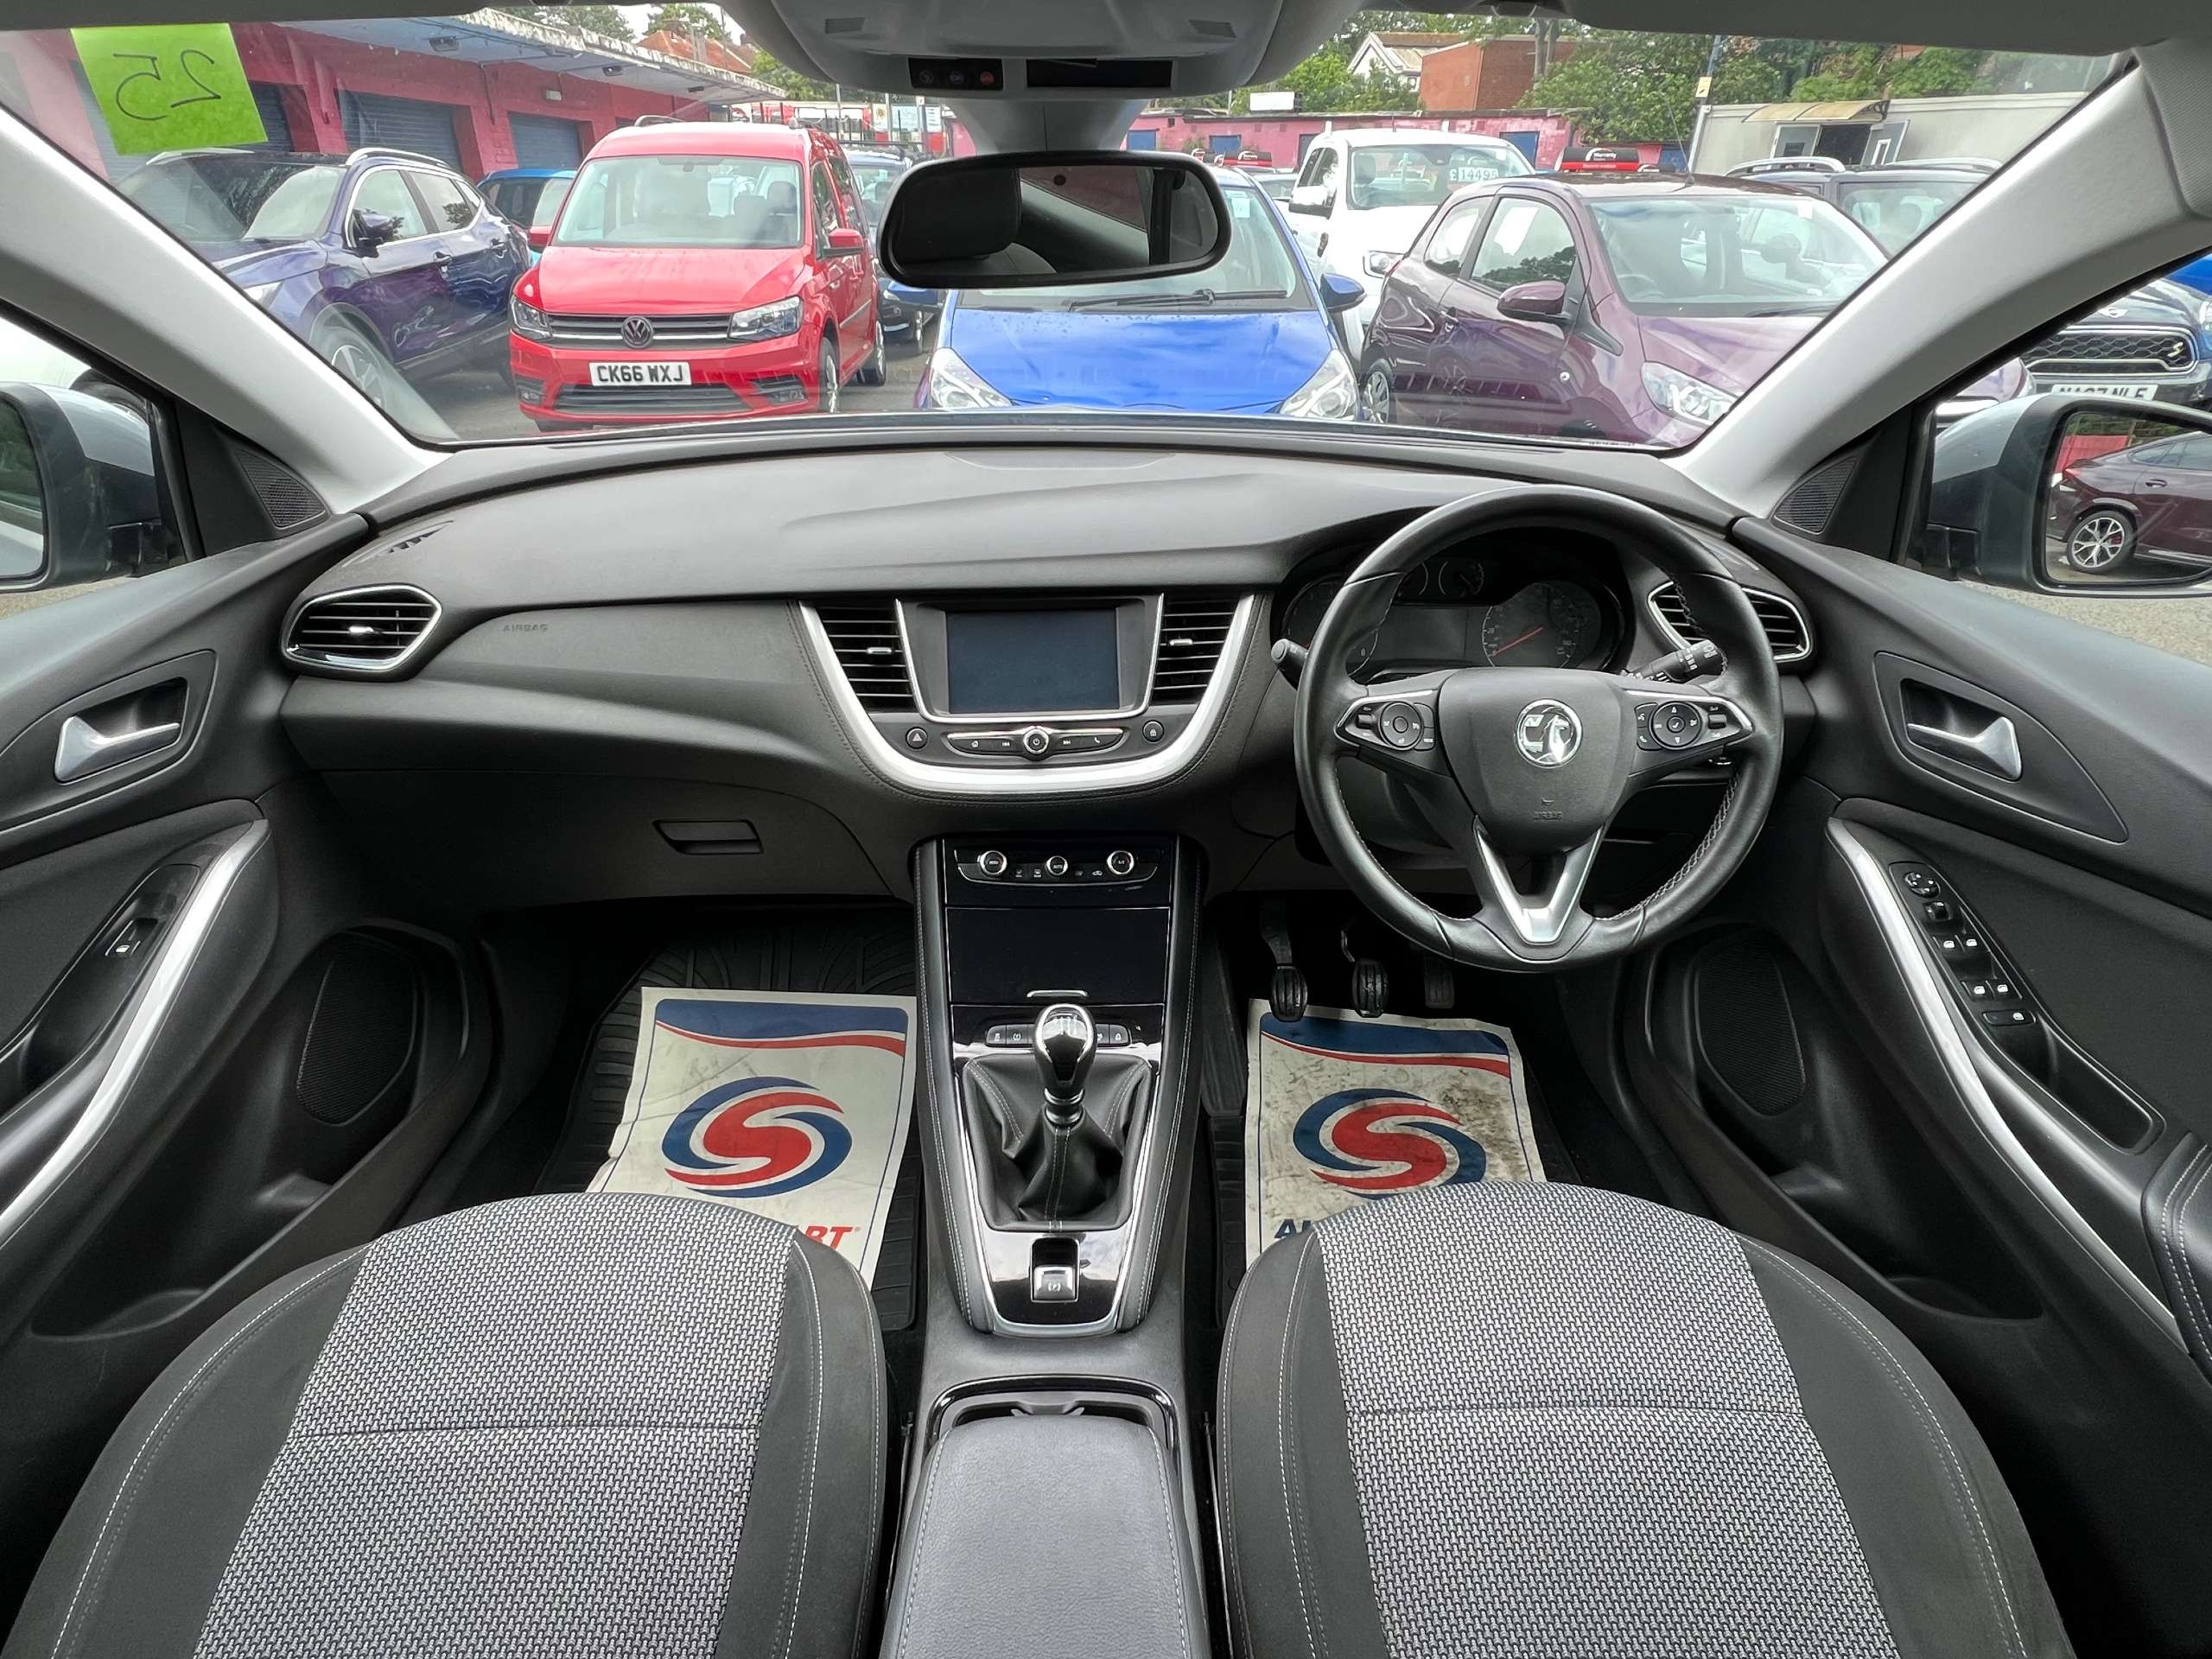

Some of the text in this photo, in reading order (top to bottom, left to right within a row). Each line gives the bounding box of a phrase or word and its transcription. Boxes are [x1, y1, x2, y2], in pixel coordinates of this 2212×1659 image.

[596, 365, 683, 383] CK66 WXJ
[503, 623, 549, 633] AIRBAG
